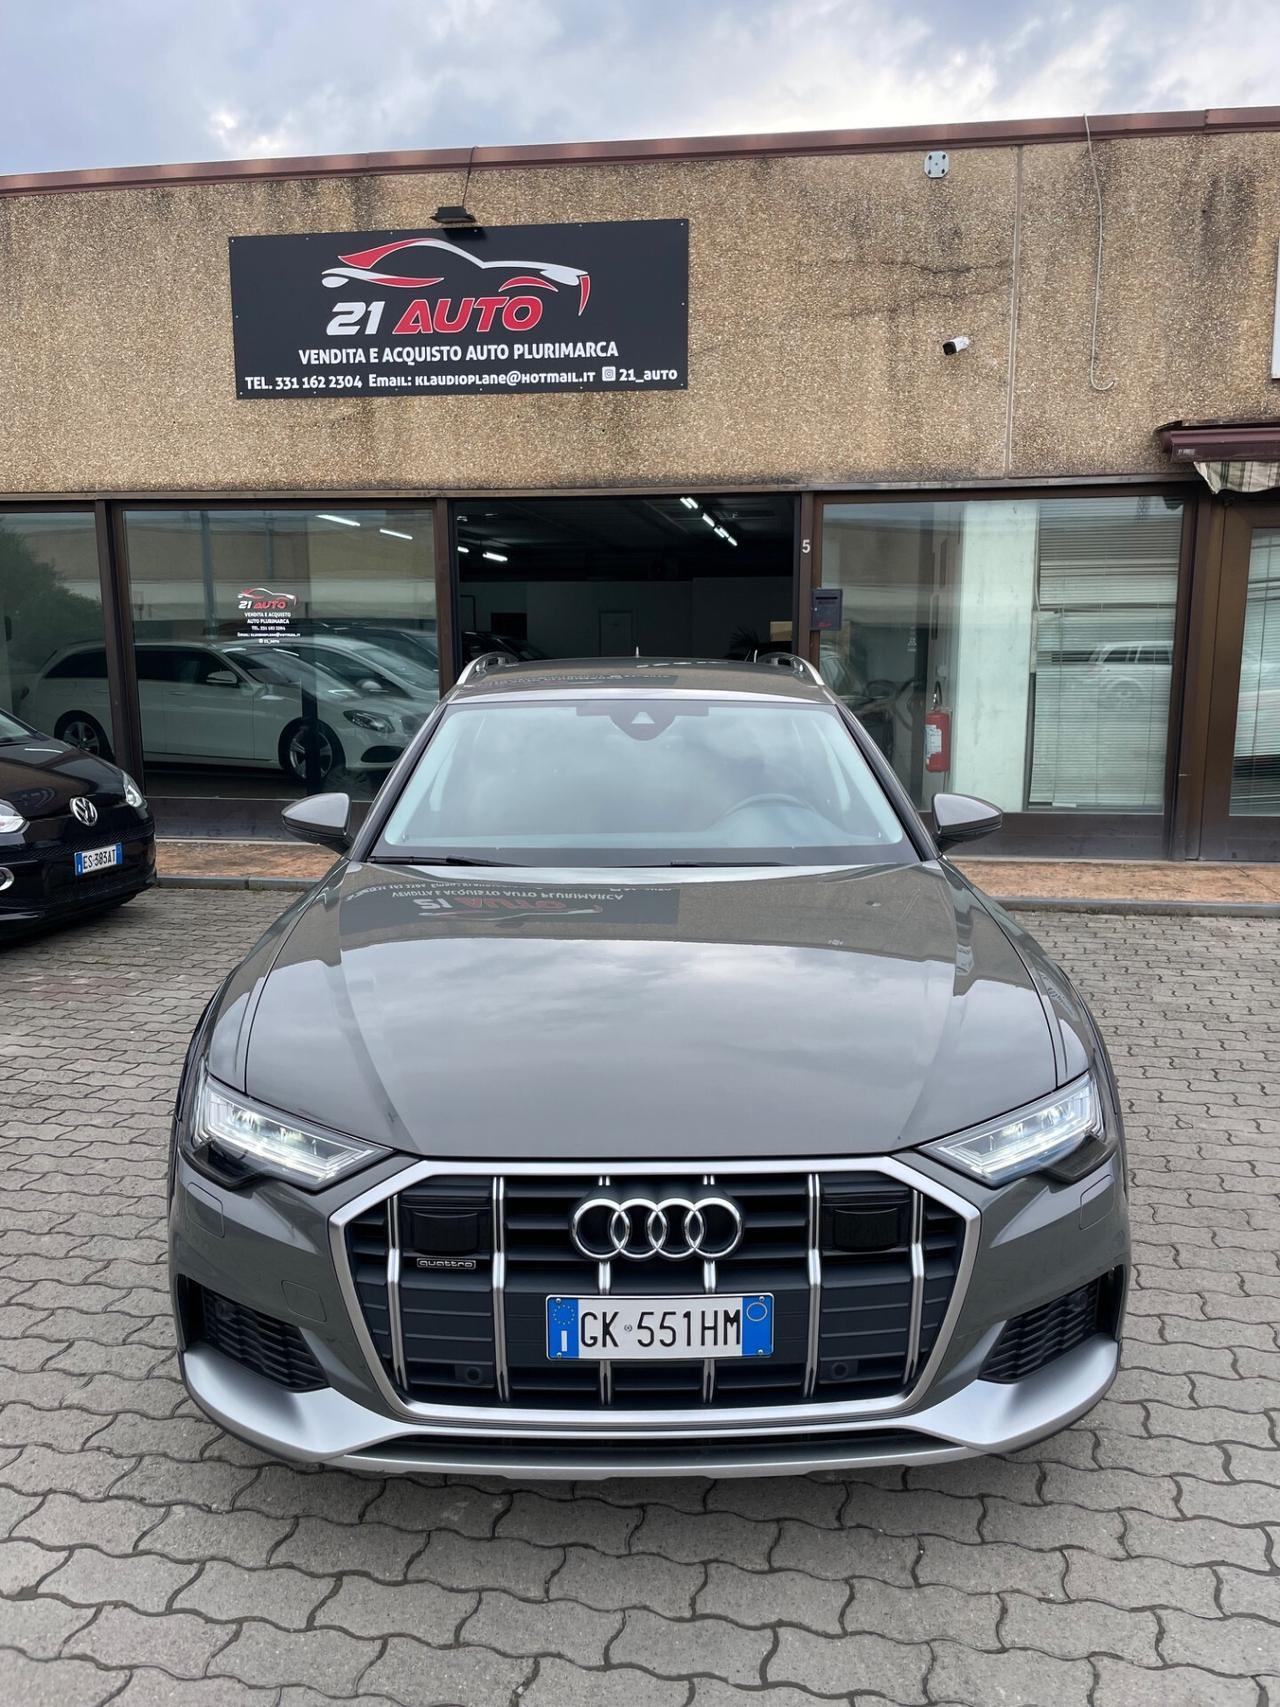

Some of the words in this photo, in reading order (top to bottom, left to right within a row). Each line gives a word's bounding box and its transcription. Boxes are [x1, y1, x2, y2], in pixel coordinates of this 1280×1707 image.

[326, 301, 386, 336] 21
[392, 295, 543, 335] AUTO
[298, 347, 367, 365] VENDITA
[370, 347, 379, 363] E
[382, 345, 462, 366] ACQUISTO
[466, 344, 509, 361] AUTO
[513, 341, 620, 359] PLURIMARCA
[245, 376, 273, 390] TEL.
[275, 376, 299, 390] 331
[302, 375, 326, 389] 162
[328, 374, 363, 389] 2304
[802, 539, 811, 553] 5
[238, 600, 253, 609] 21
[253, 600, 286, 609] AUTO
[83, 855, 93, 869] ES
[419, 1260, 473, 1268] quattro
[580, 1311, 620, 1347] GK
[637, 1309, 741, 1347] 551HM
